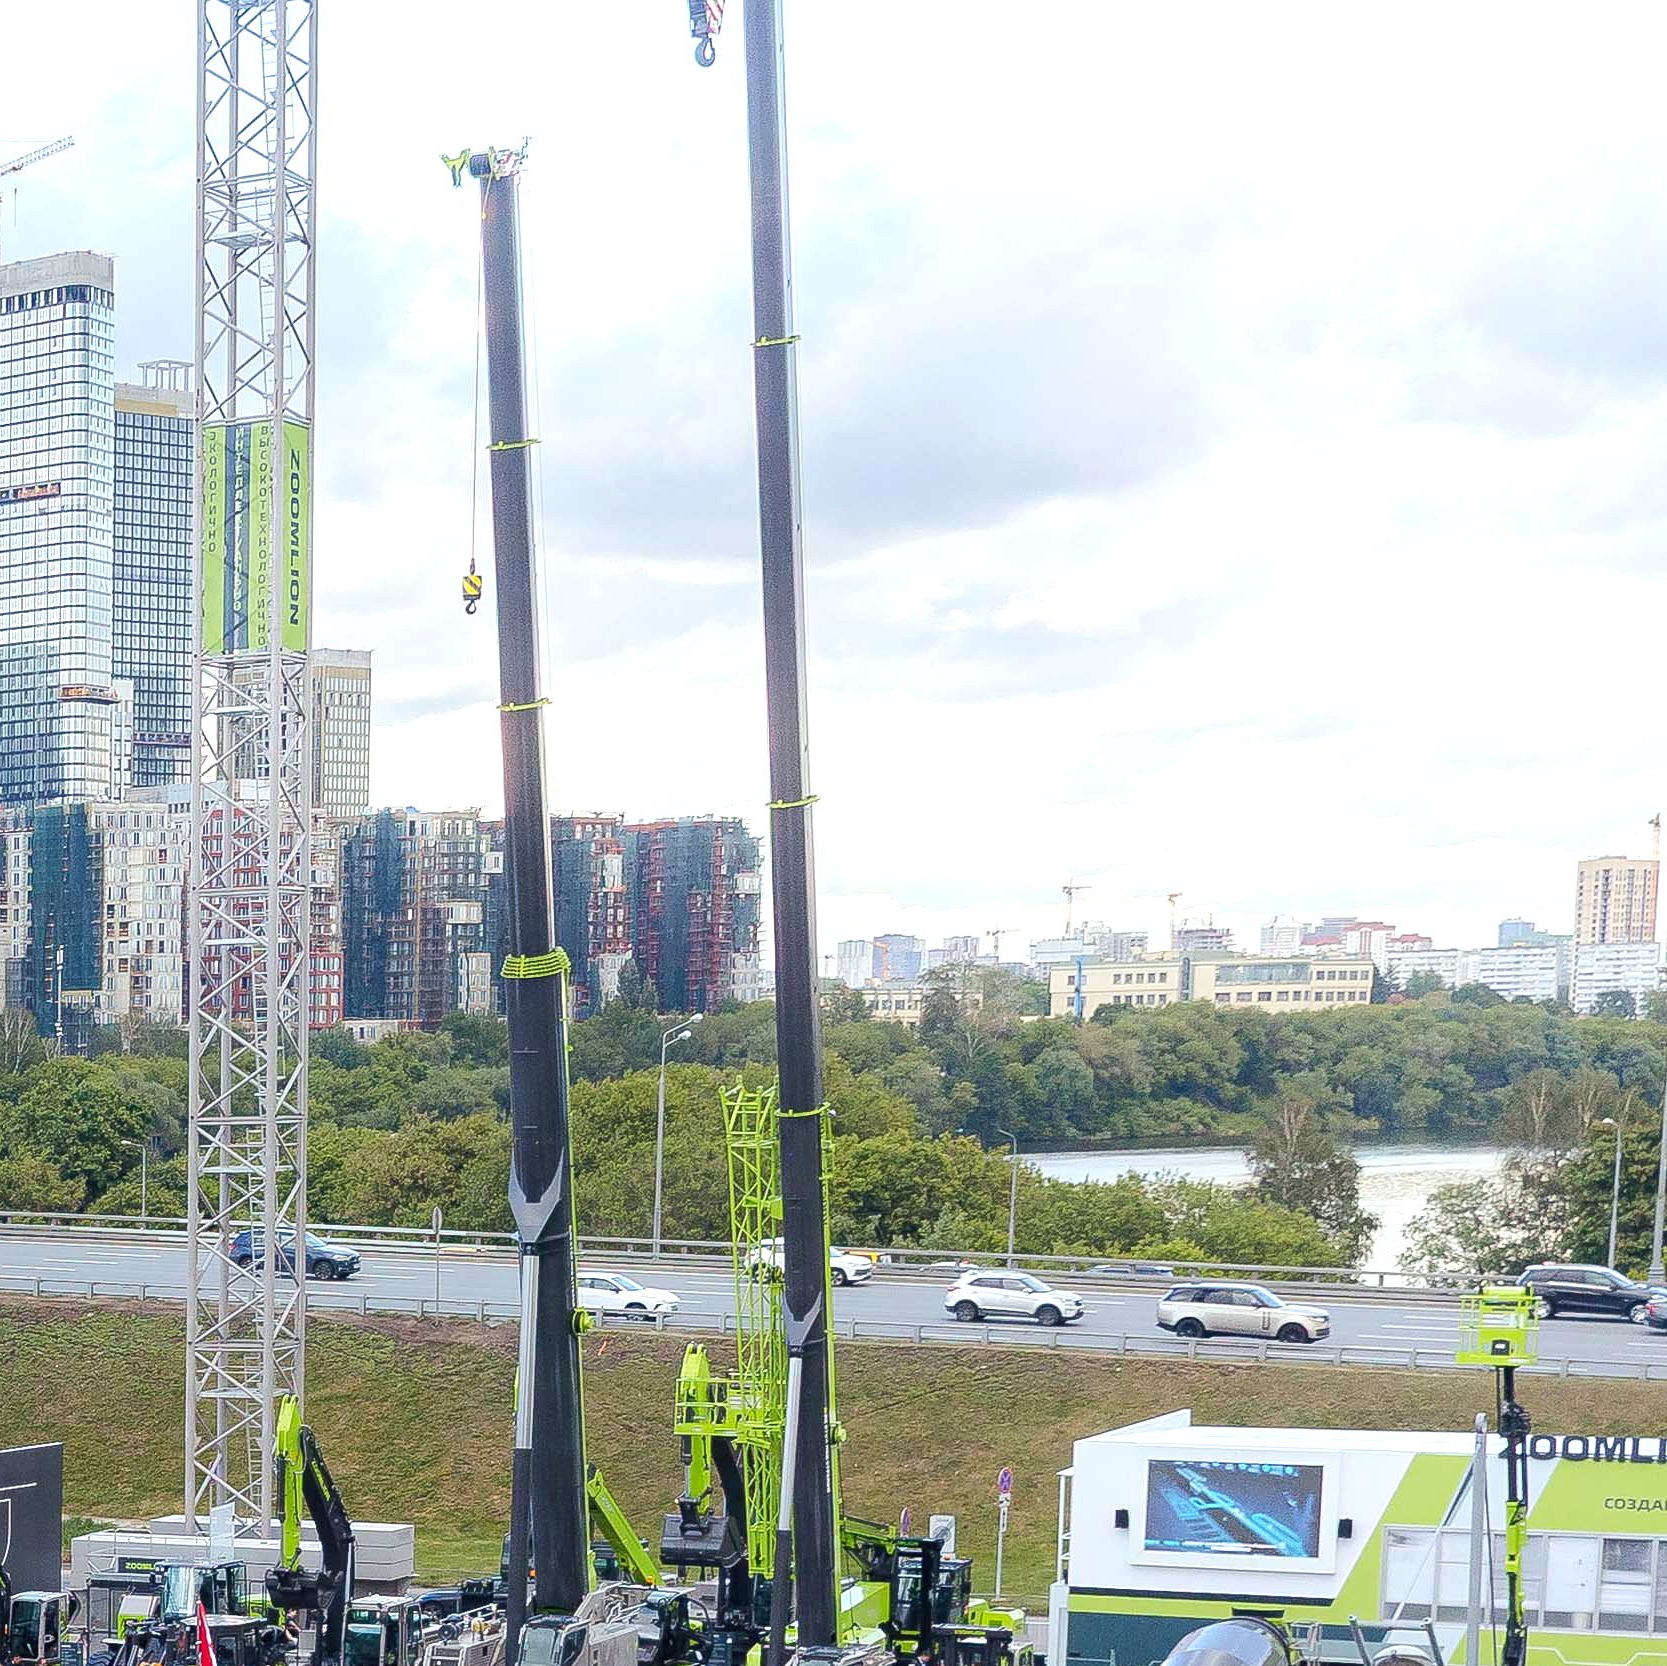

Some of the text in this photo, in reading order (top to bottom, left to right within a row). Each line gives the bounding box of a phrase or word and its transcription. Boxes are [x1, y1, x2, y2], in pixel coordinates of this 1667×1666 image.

[208, 431, 217, 553] ЭКОЛОГИЧНО
[289, 448, 301, 626] ZOOMLION
[1604, 1497, 1667, 1512] СОЗДА
